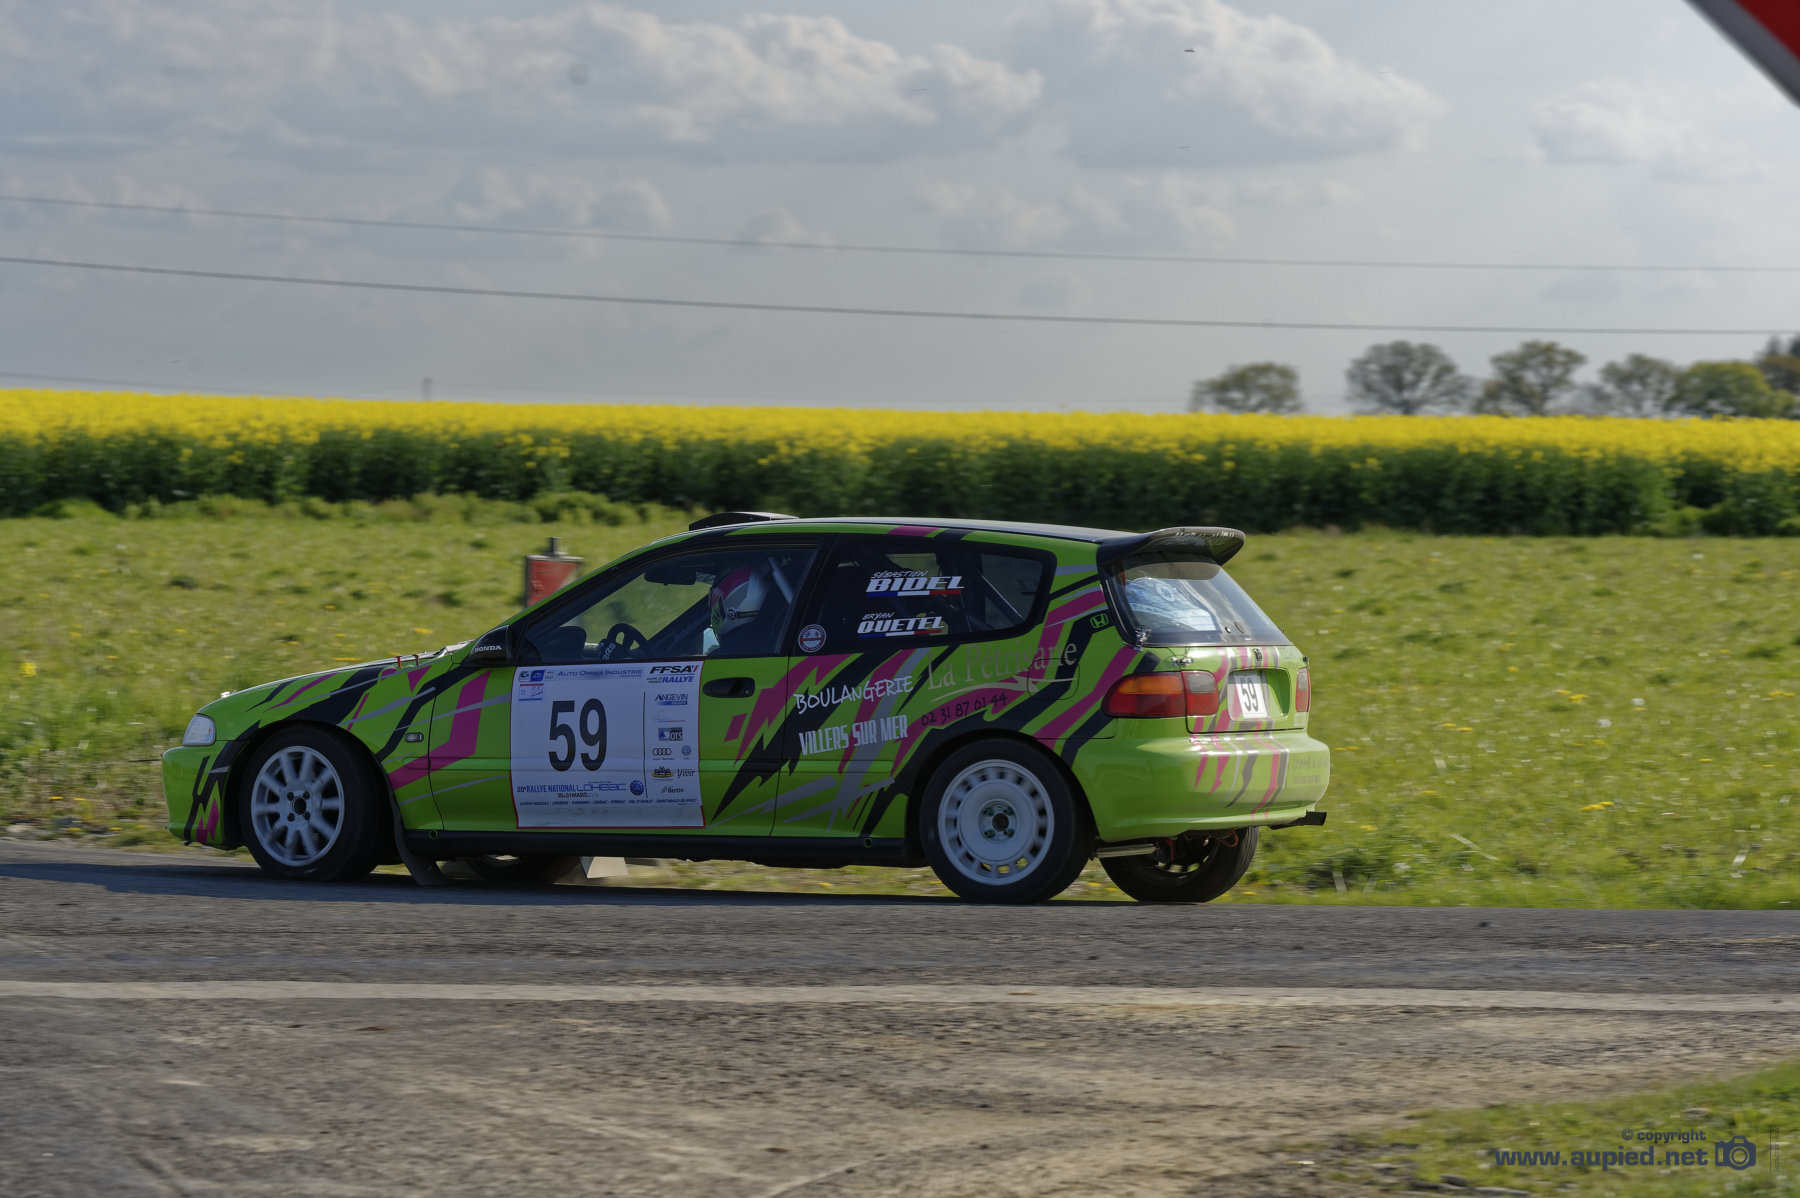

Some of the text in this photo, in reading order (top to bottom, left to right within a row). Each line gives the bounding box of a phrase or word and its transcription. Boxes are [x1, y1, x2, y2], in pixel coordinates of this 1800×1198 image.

[865, 576, 965, 592] BIDEL
[857, 616, 945, 633] QUETEL
[472, 645, 502, 653] HONDA
[649, 665, 692, 674] FFSA
[927, 655, 957, 690] La
[793, 676, 915, 714] BOULANGERIE
[920, 712, 937, 727] 02
[940, 708, 951, 725] 31
[954, 702, 971, 718] 87
[991, 692, 1008, 709] 44
[1240, 677, 1260, 712] 59
[548, 698, 608, 771] 59
[798, 714, 909, 756] VILLERS SUR MER
[526, 784, 547, 792] RALLYE
[549, 783, 576, 792] NATIONAL
